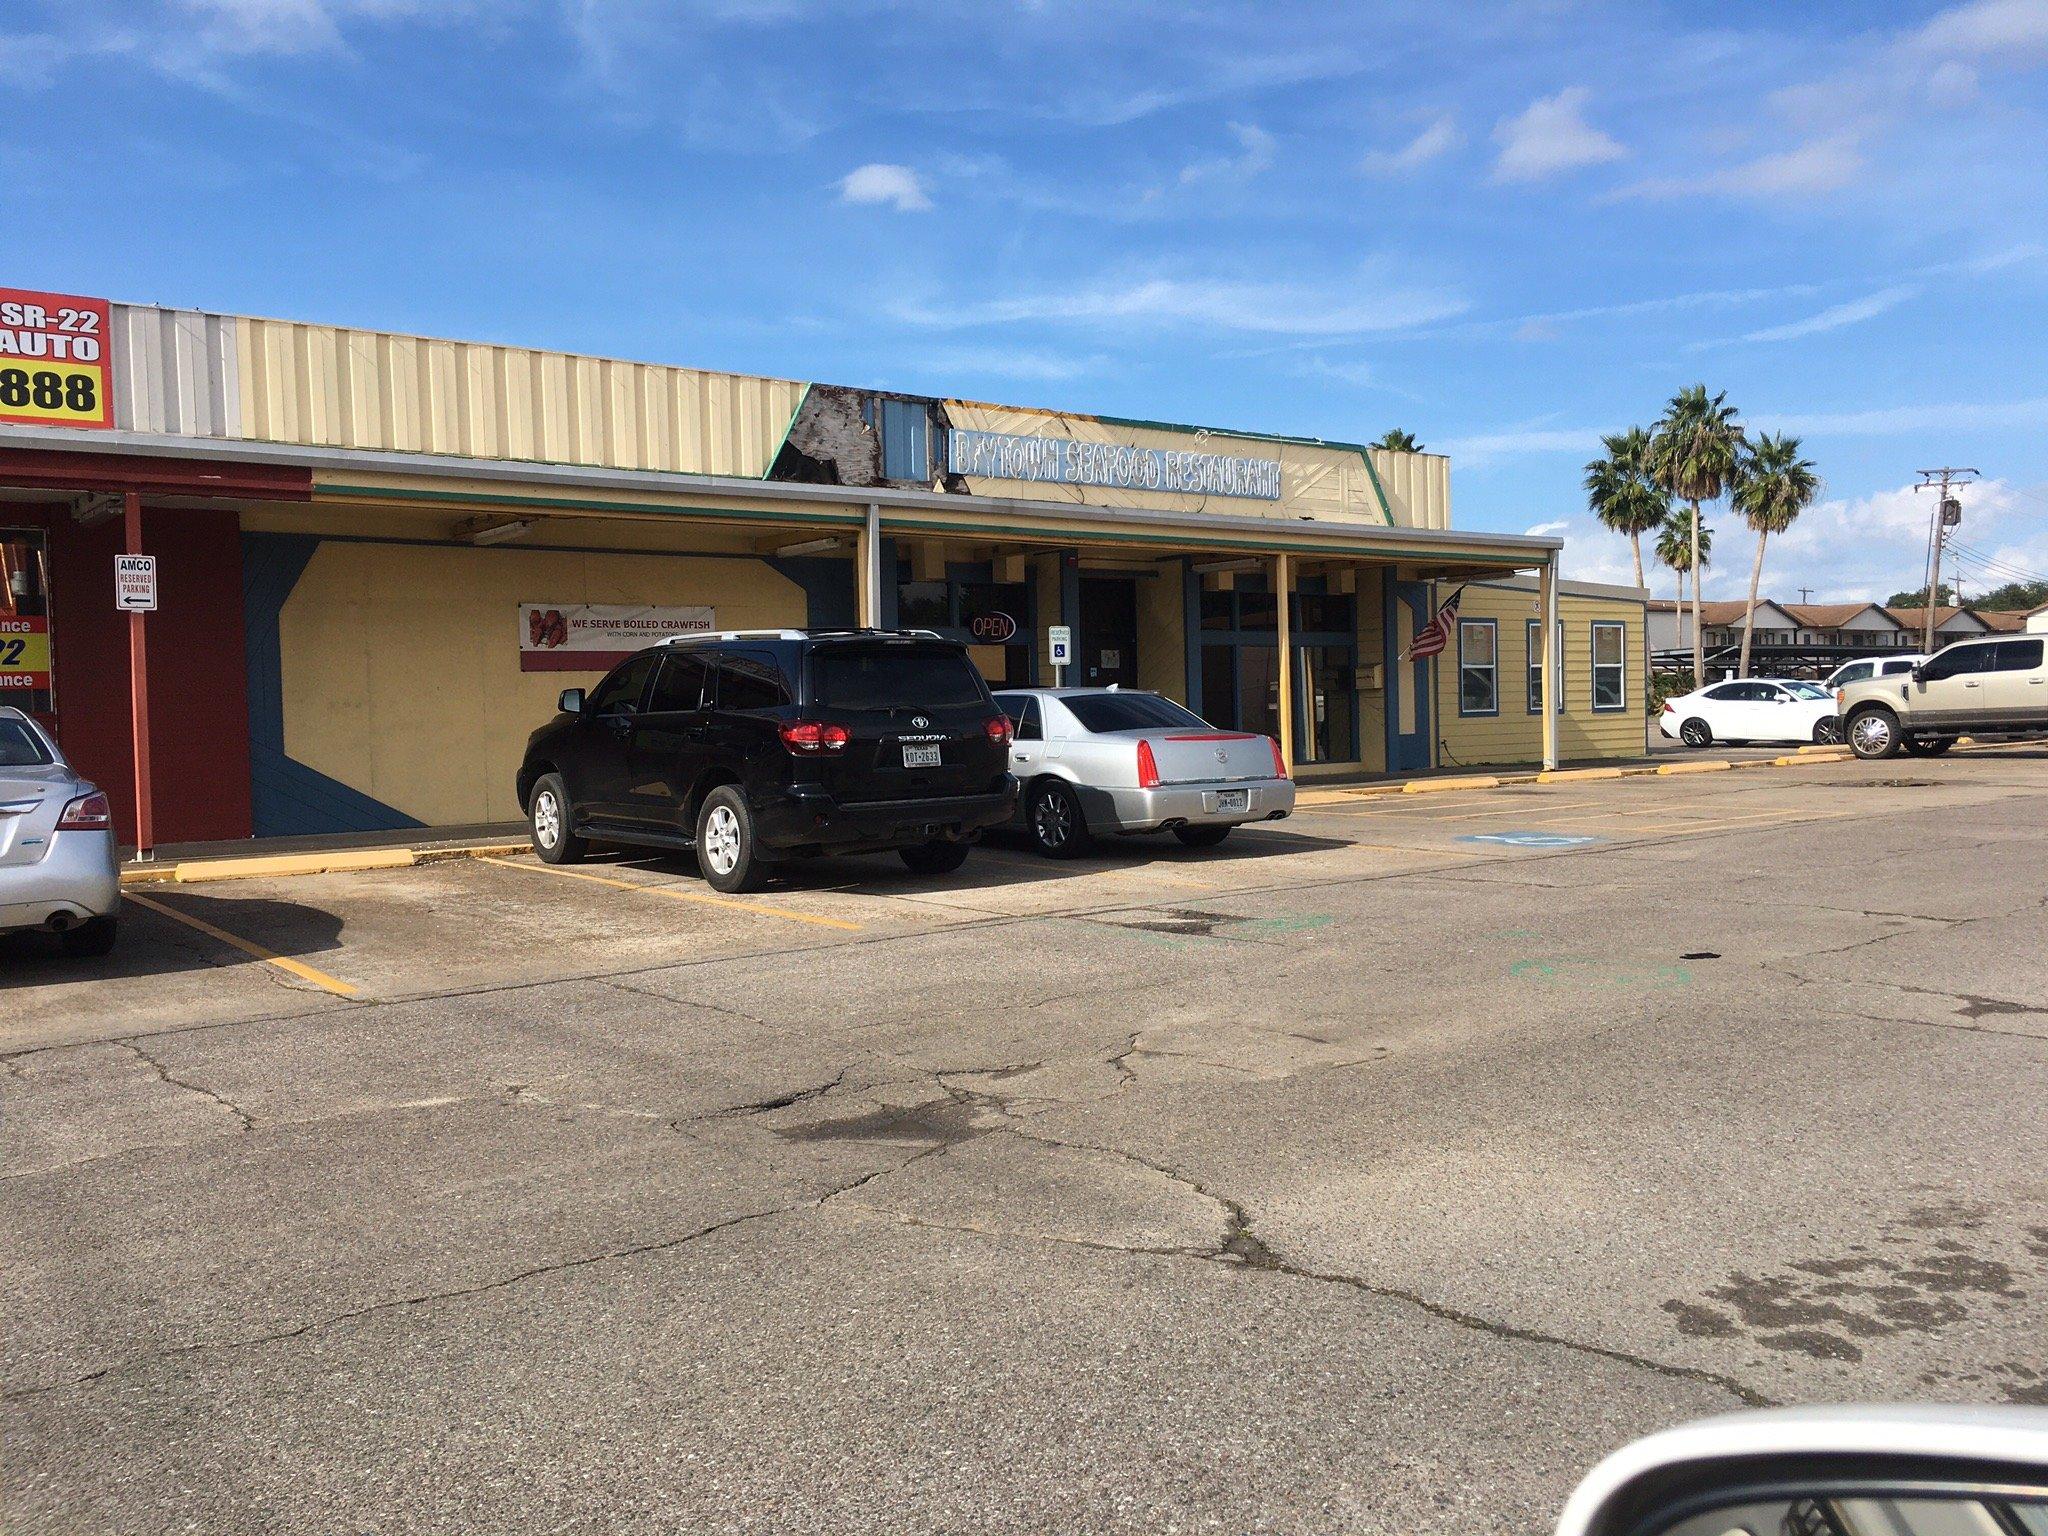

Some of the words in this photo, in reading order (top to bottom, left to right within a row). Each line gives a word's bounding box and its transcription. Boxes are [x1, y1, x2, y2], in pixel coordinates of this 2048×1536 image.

[0, 302, 99, 334] SR-22
[0, 328, 100, 361] AUTO
[0, 368, 96, 412] 888
[1065, 441, 1160, 489] SEAFOOD
[1165, 451, 1282, 498] RESTAURANT
[120, 560, 151, 571] AMCO
[120, 574, 152, 584] RESERVED
[122, 584, 150, 594] PARKING
[572, 620, 588, 628] WE
[590, 620, 621, 629] SERVE
[623, 620, 659, 629] BOILED
[661, 621, 710, 629] CRAWFISH
[973, 618, 1009, 637] OPEN
[898, 734, 947, 742] SEQUOIA
